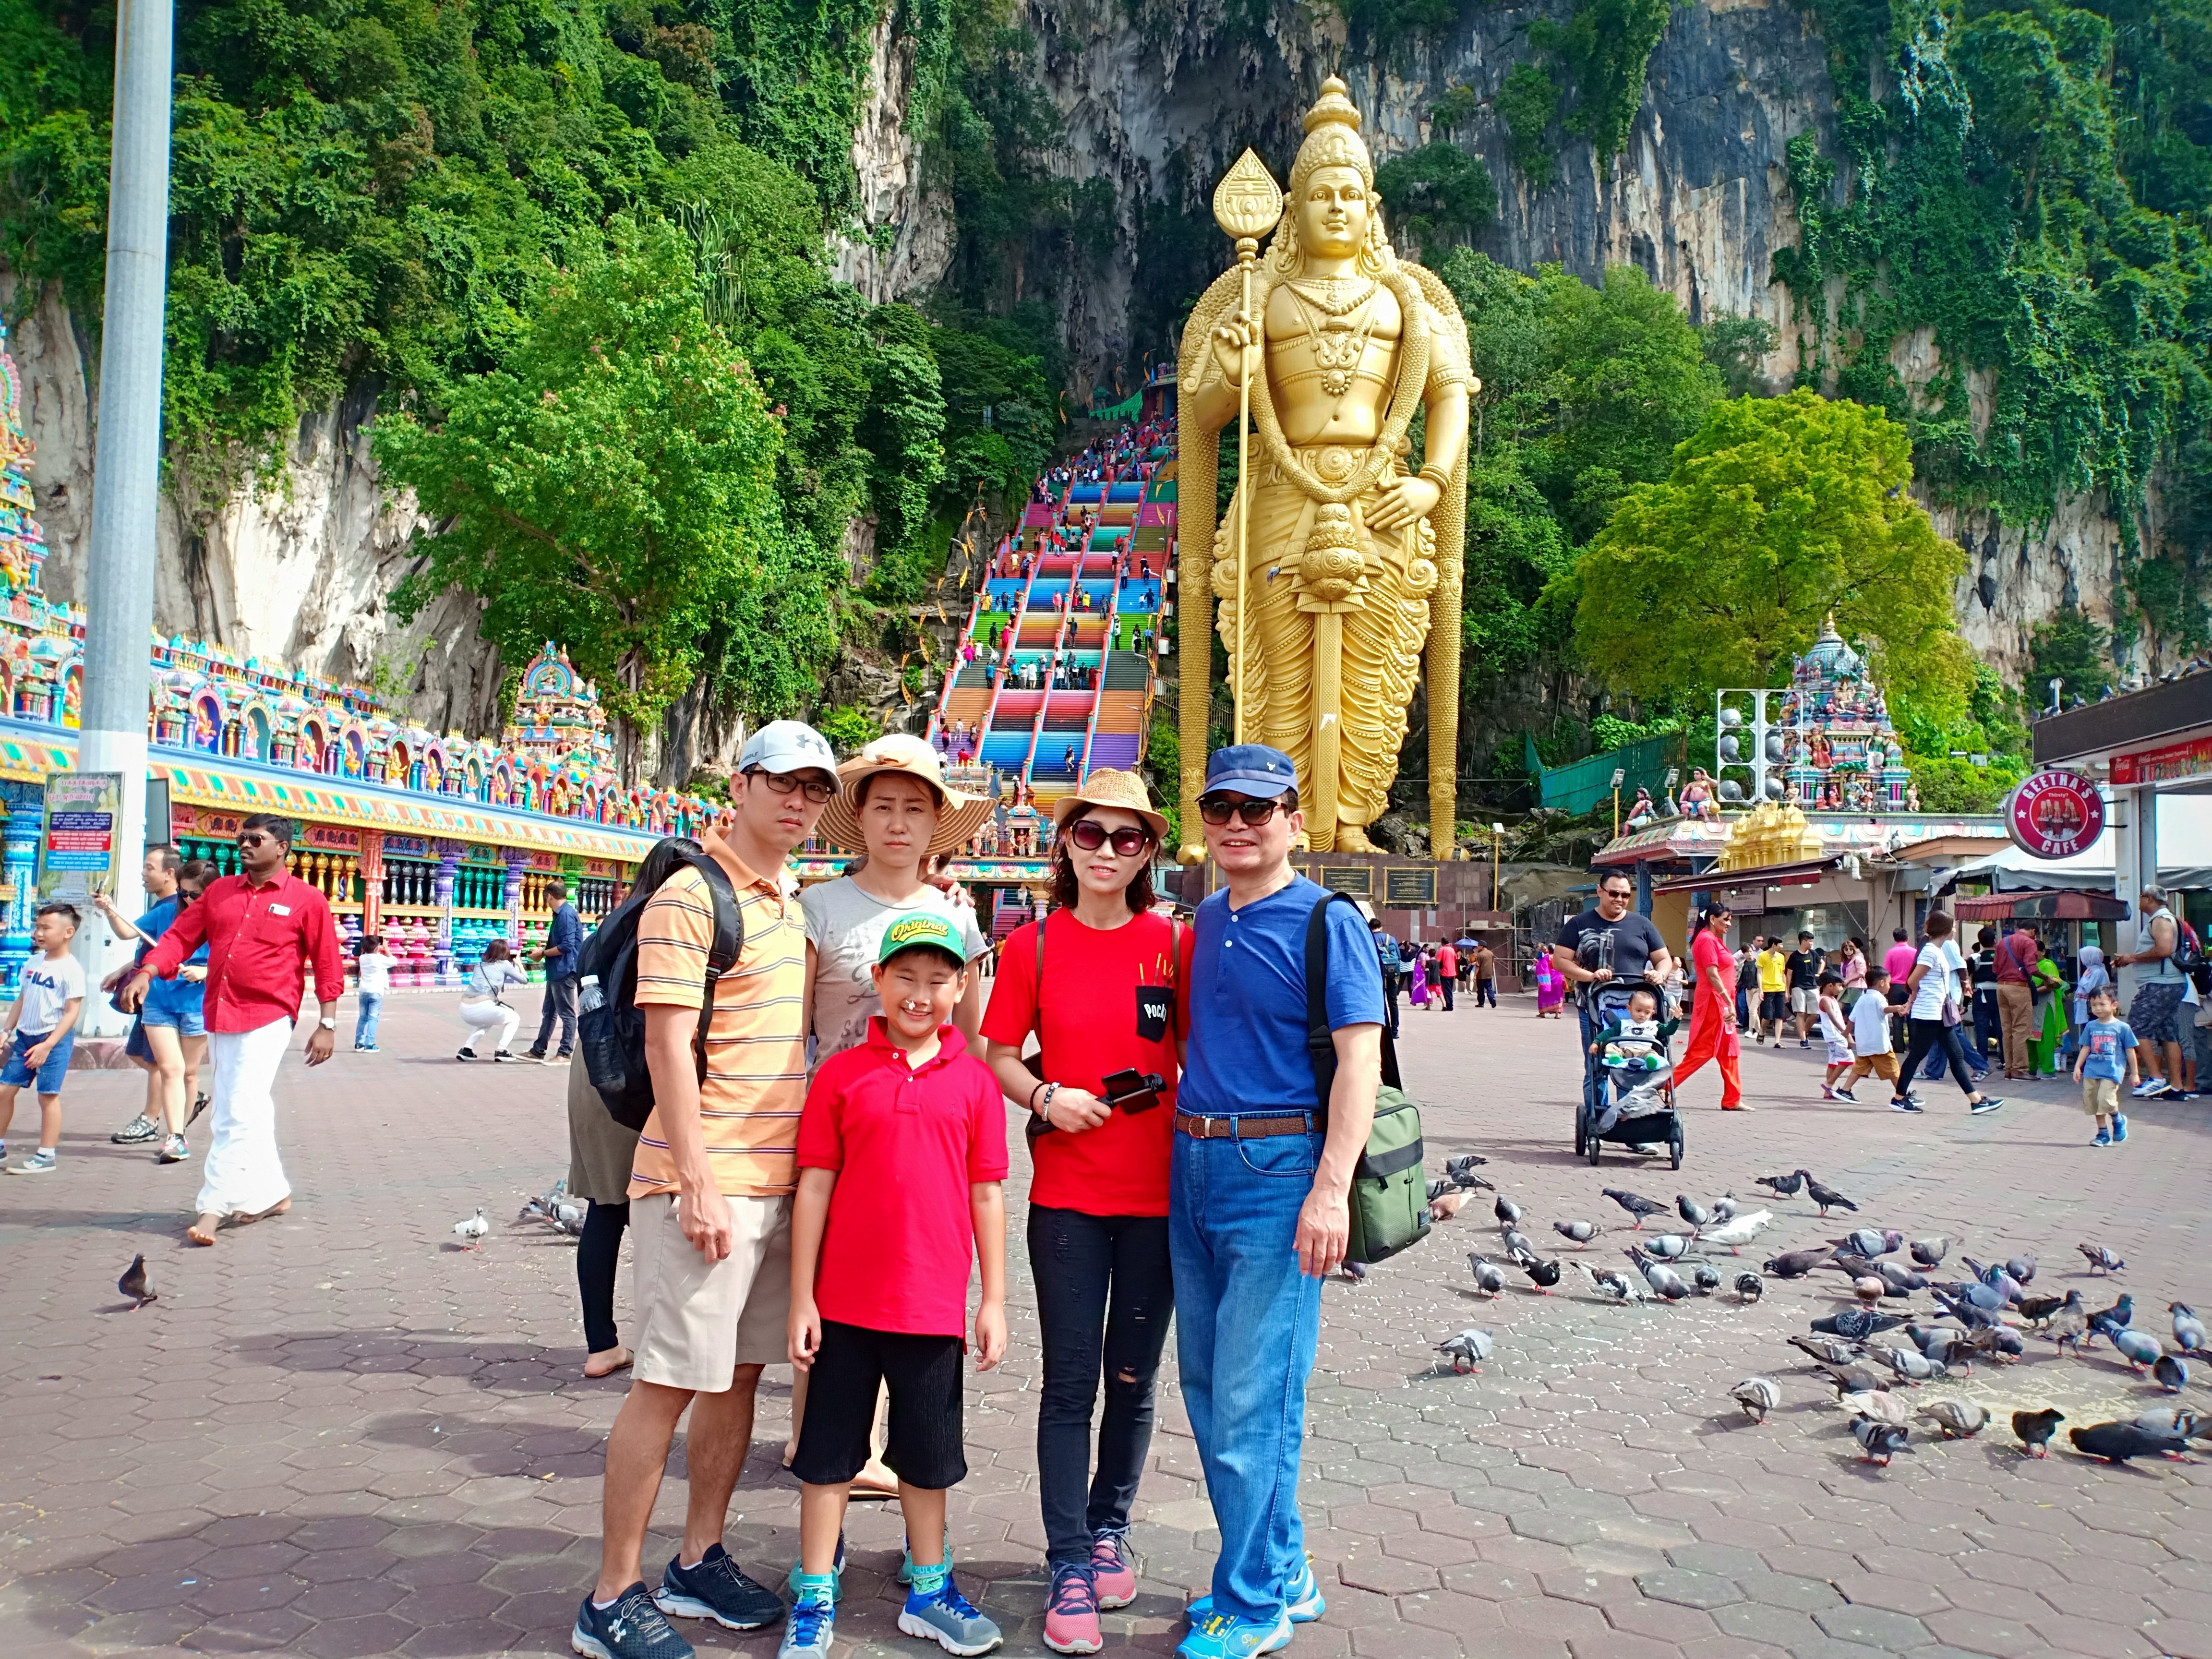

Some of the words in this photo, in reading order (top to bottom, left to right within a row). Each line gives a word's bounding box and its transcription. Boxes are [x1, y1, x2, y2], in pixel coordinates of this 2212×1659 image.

[2022, 774, 2093, 800] GEETHA'S
[2041, 839, 2079, 854] CAFE
[891, 919, 949, 942] Original
[26, 971, 55, 989] FILA
